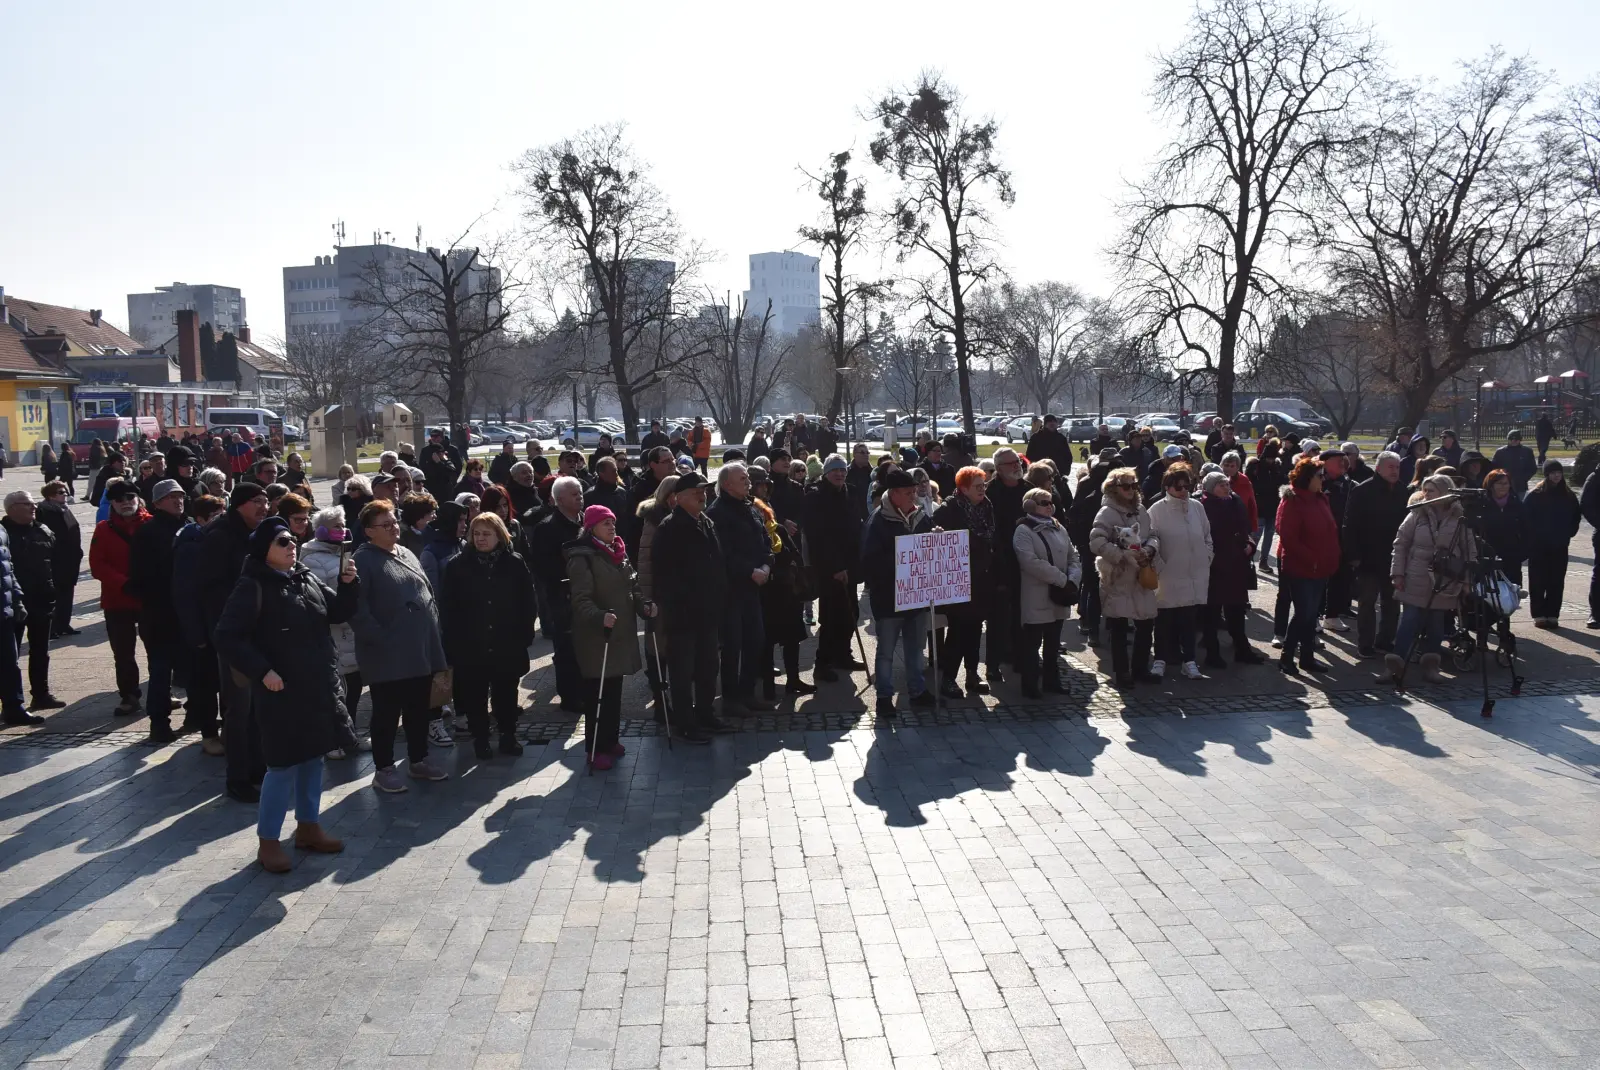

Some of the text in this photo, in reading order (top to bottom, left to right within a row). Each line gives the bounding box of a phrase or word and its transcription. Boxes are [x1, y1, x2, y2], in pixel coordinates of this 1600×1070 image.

[897, 551, 907, 565] NE
[909, 548, 934, 564] DAJMO
[949, 546, 958, 559] DA
[910, 562, 926, 577] GAZE
[946, 571, 969, 585] GLAVE
